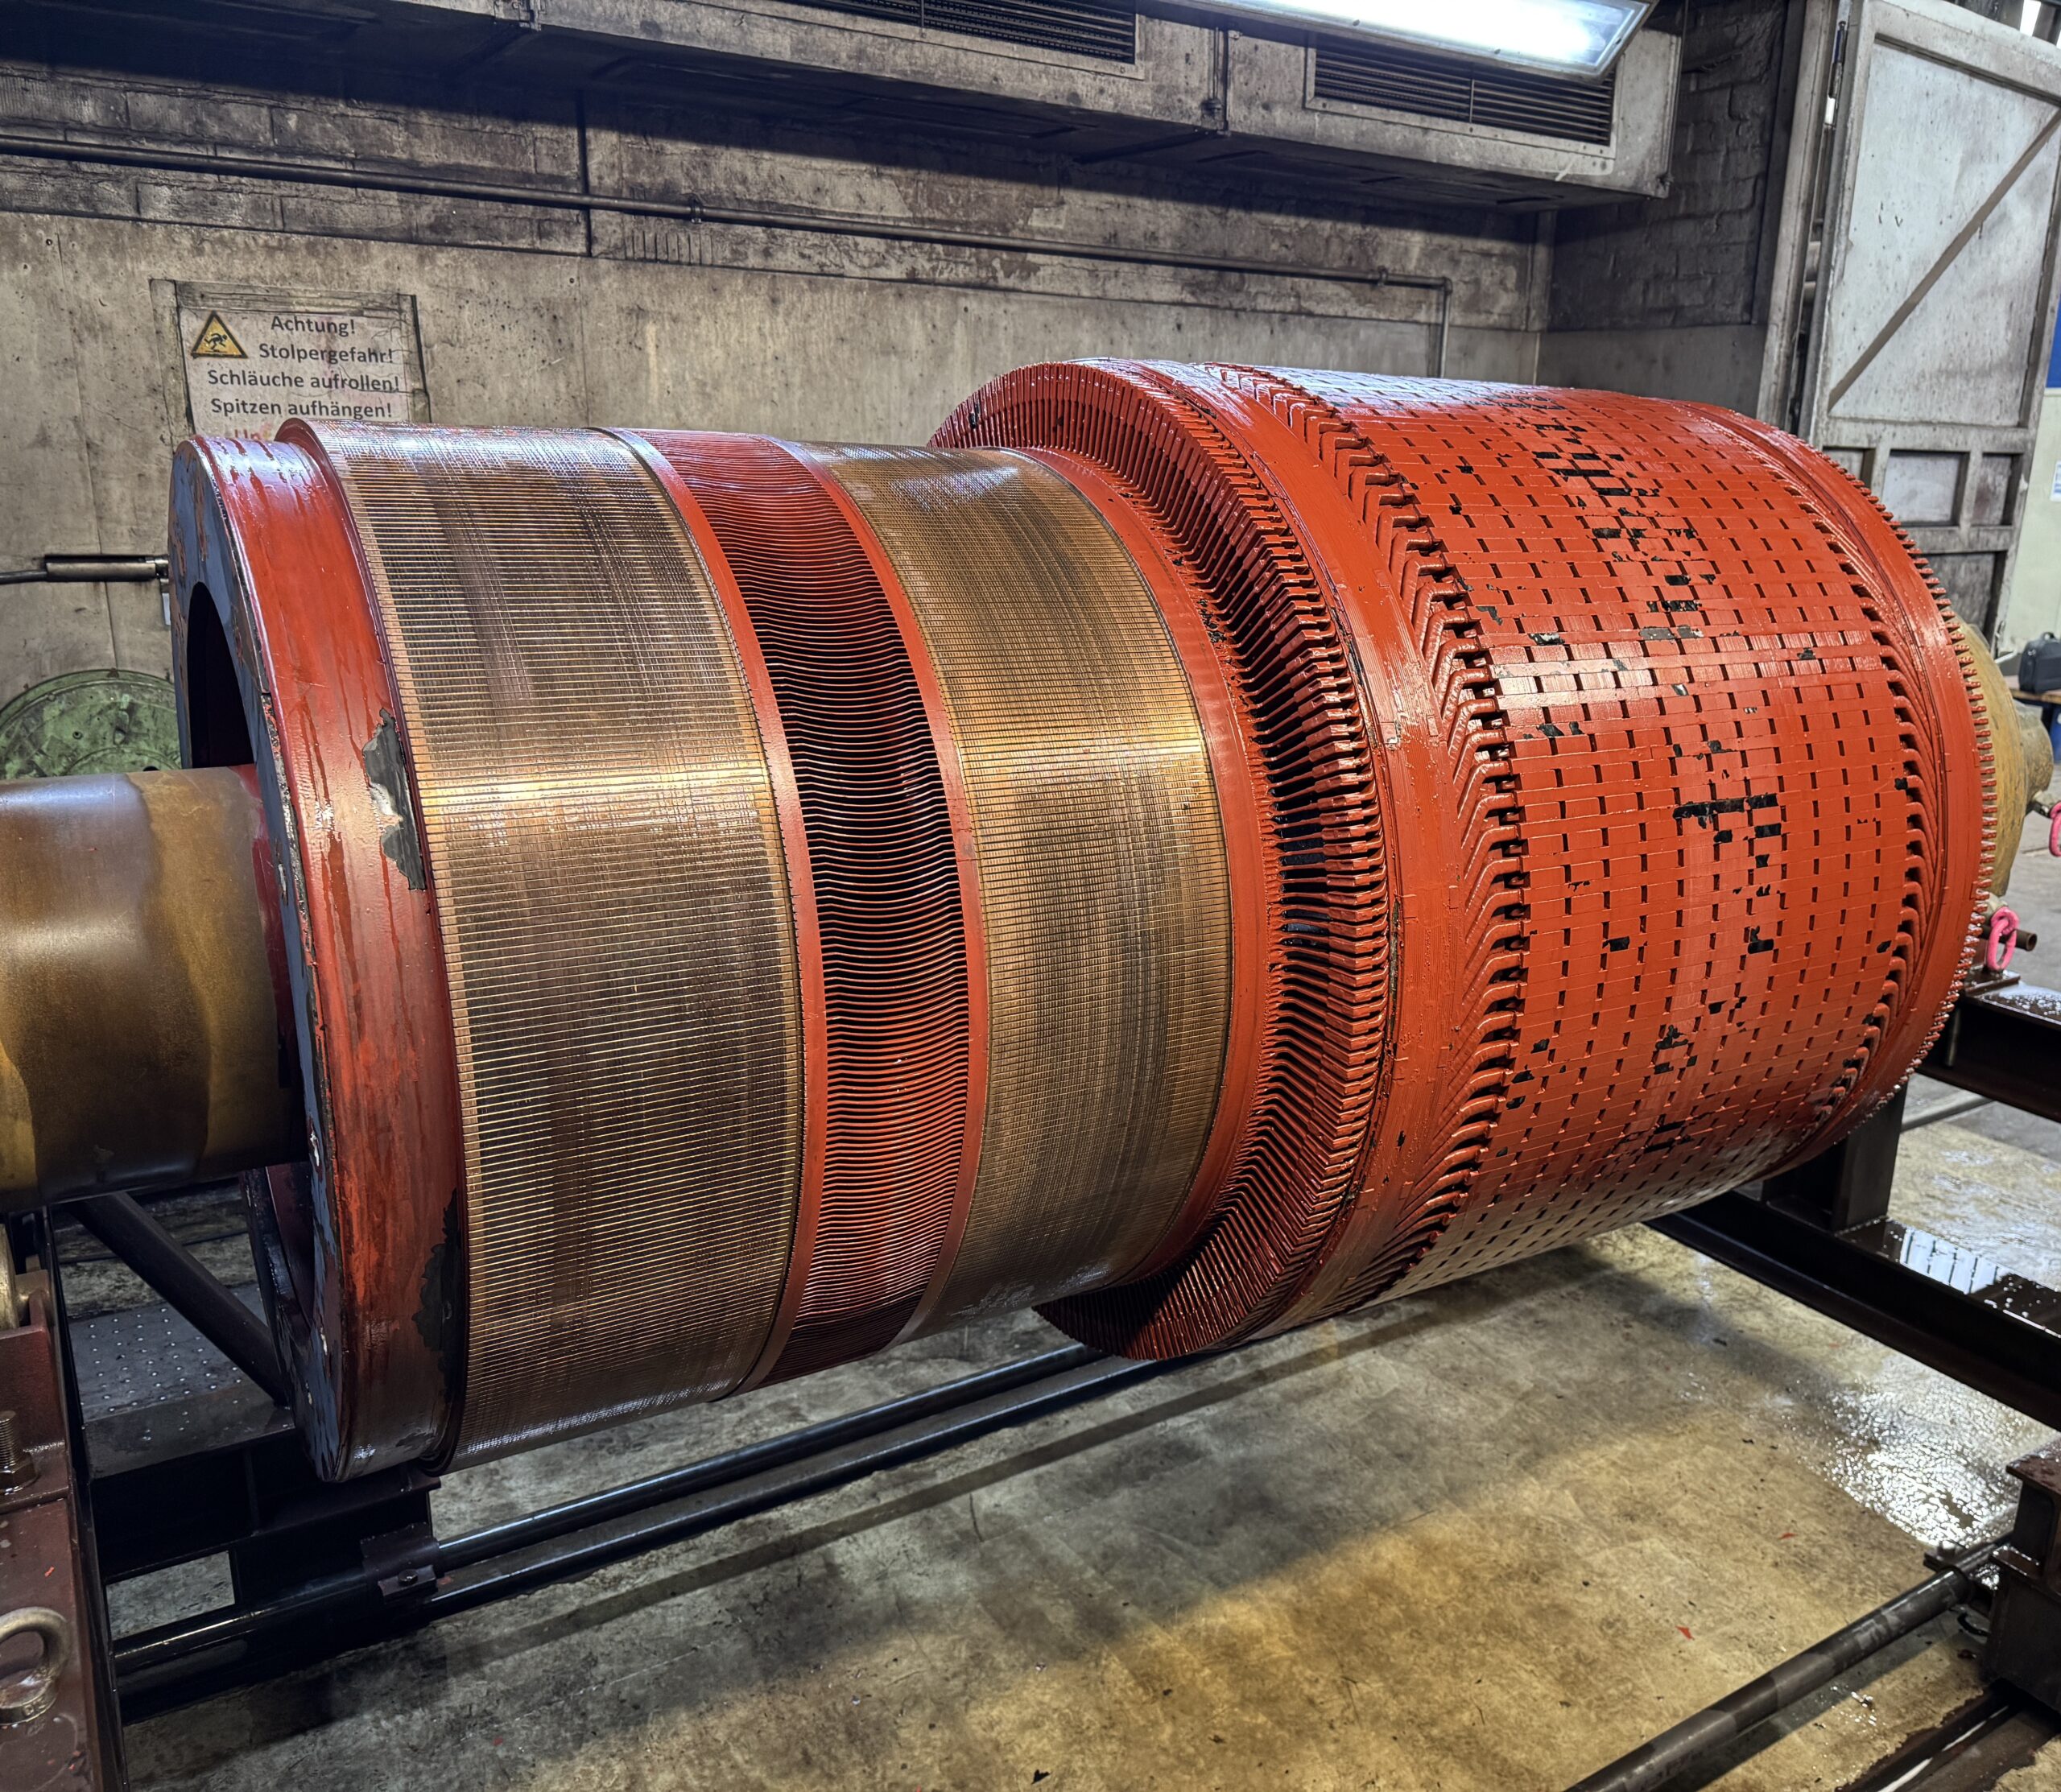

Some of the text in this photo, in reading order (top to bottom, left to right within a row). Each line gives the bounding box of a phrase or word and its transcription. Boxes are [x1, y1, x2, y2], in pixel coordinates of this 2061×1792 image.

[271, 315, 354, 337] Achtung!
[258, 343, 393, 365] Stolpergefahr!
[208, 370, 400, 392] Schläuche aufrollen!
[211, 398, 392, 419] Spitzen aufhängen!
